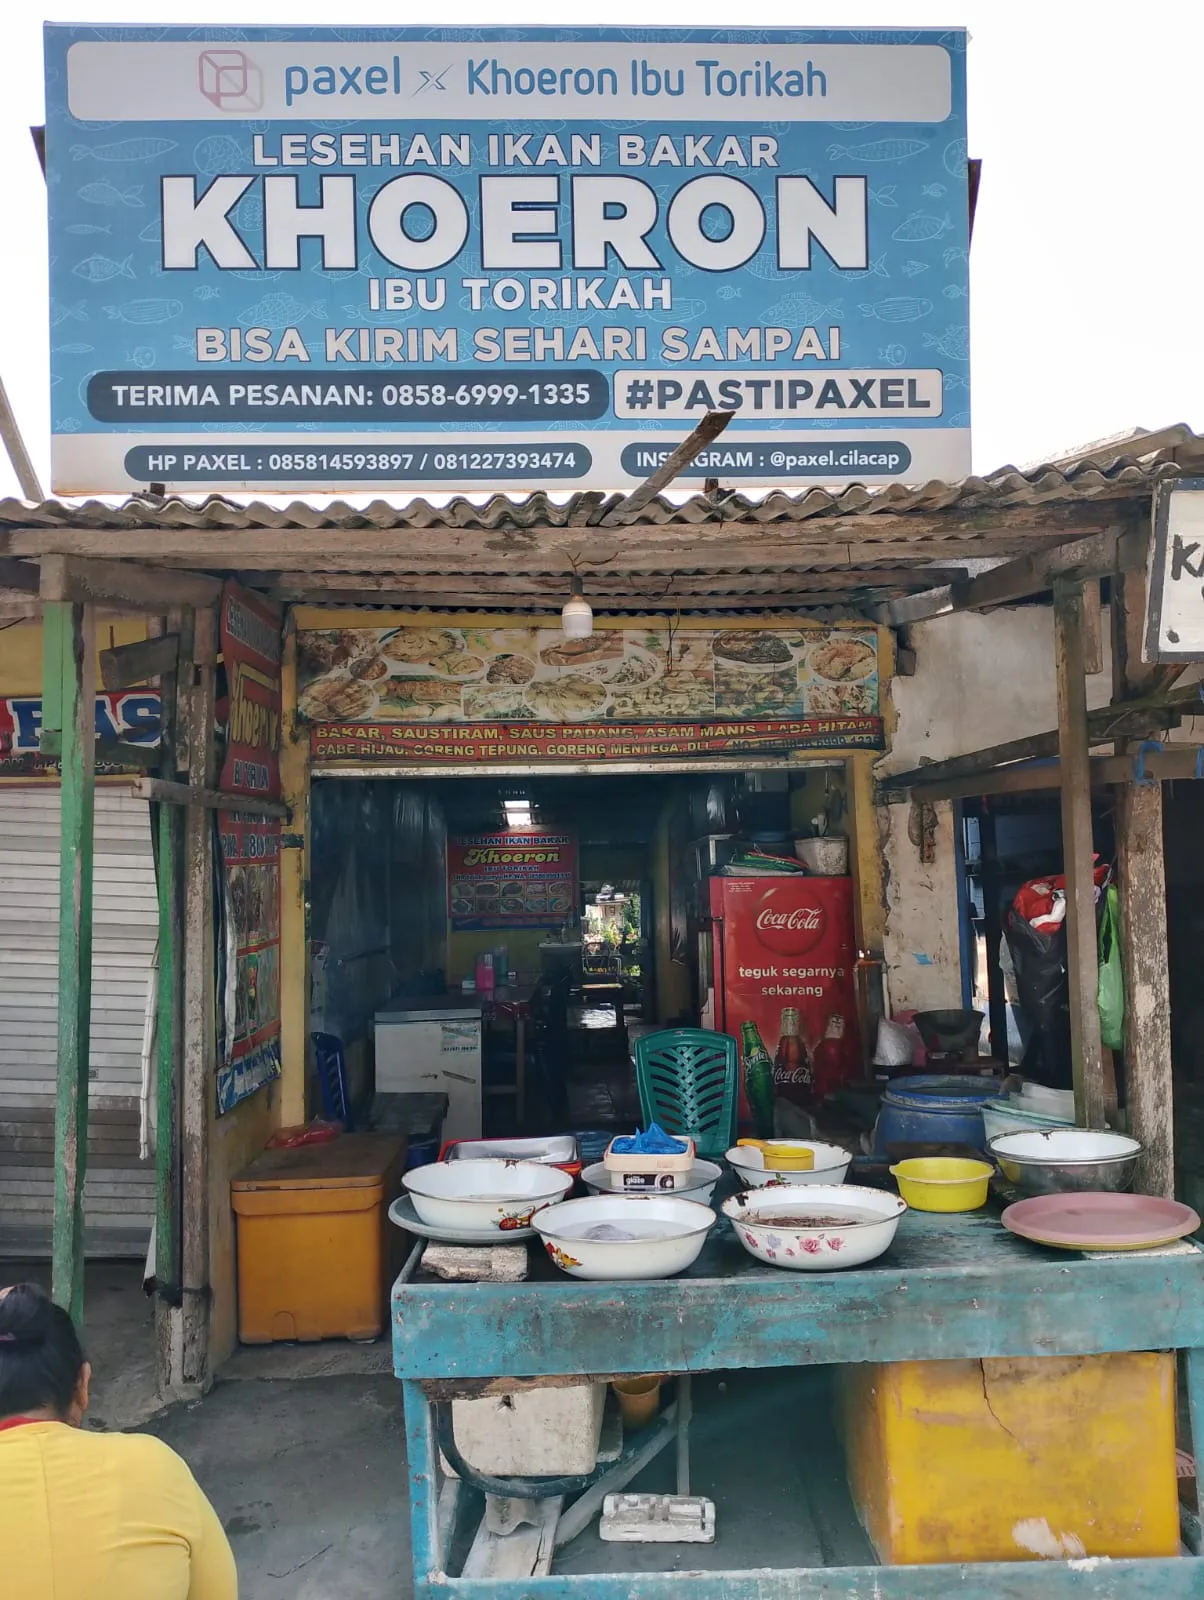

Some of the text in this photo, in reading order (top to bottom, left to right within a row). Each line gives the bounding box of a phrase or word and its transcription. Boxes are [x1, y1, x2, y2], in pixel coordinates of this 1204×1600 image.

[285, 56, 400, 105] paxel
[468, 59, 617, 96] Khoeron
[632, 61, 684, 96] Ibu
[696, 61, 827, 97] Torikah
[253, 133, 780, 168] LESEHAN IKAN BAKAR
[160, 172, 869, 272] KHOERON
[369, 277, 673, 311] IBU TORIKAH
[195, 326, 841, 363] BISA KIRIM SEHARI SAMPAI
[112, 383, 590, 407] TERIMA PESANAN: 0858-6999-1335
[625, 377, 930, 411] #PASTIPAXEL
[148, 455, 178, 471] HP
[184, 454, 250, 471] PAXEL
[269, 453, 413, 470] 085814593897
[434, 452, 576, 470] 081227393474
[637, 452, 753, 467] INSGRAM
[770, 450, 900, 470] @paxel.cilacap
[509, 728, 557, 739] SAUS
[645, 727, 694, 738] ASAM
[546, 744, 606, 756] GORENG
[505, 836, 531, 846] IKAN
[463, 846, 559, 867] Khoeron
[757, 908, 823, 930] Coca-Cola
[739, 966, 845, 980] teguk segarnya
[761, 984, 823, 997] sekarang
